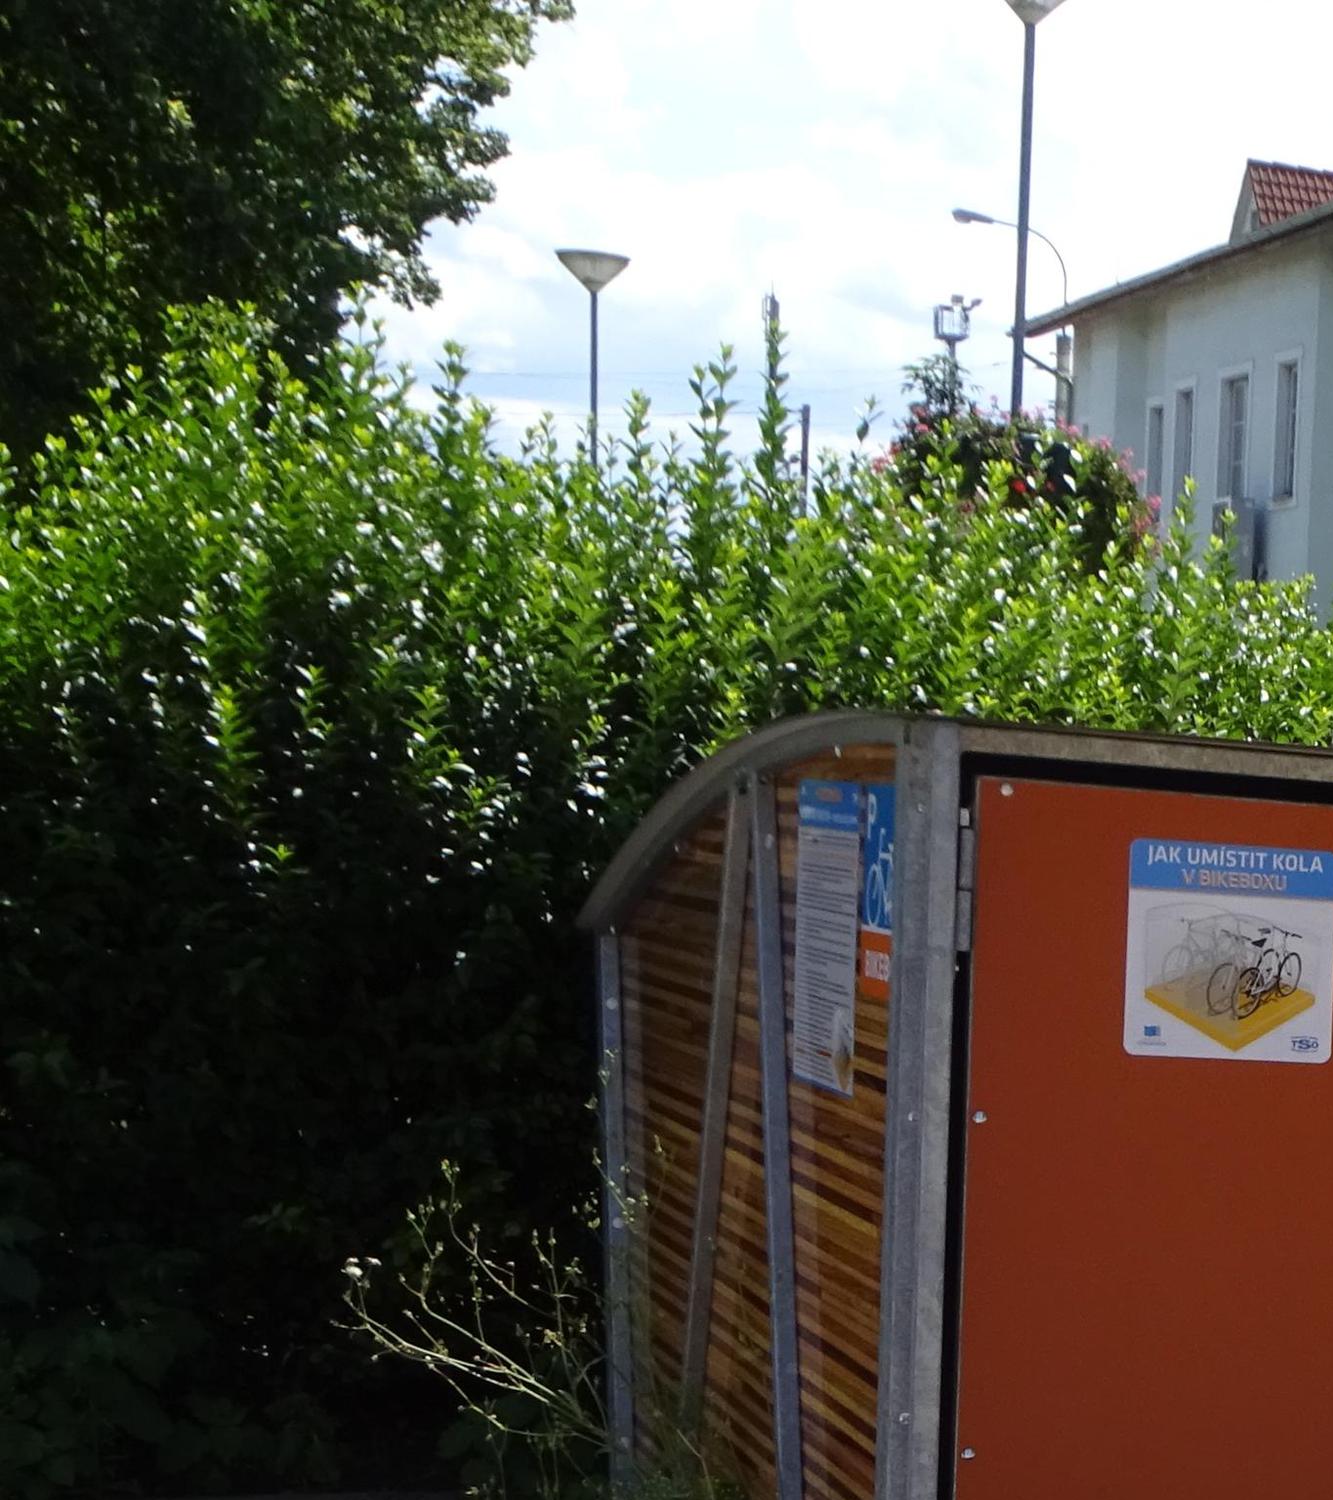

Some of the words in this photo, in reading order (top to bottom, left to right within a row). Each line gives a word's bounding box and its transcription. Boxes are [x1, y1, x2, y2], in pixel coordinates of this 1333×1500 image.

[1147, 844, 1181, 866] JAK
[1187, 847, 1268, 869] UMÍSTIT
[1272, 854, 1324, 873] KOLA
[1181, 868, 1195, 885] V
[1200, 870, 1288, 891] BIKEBOXU
